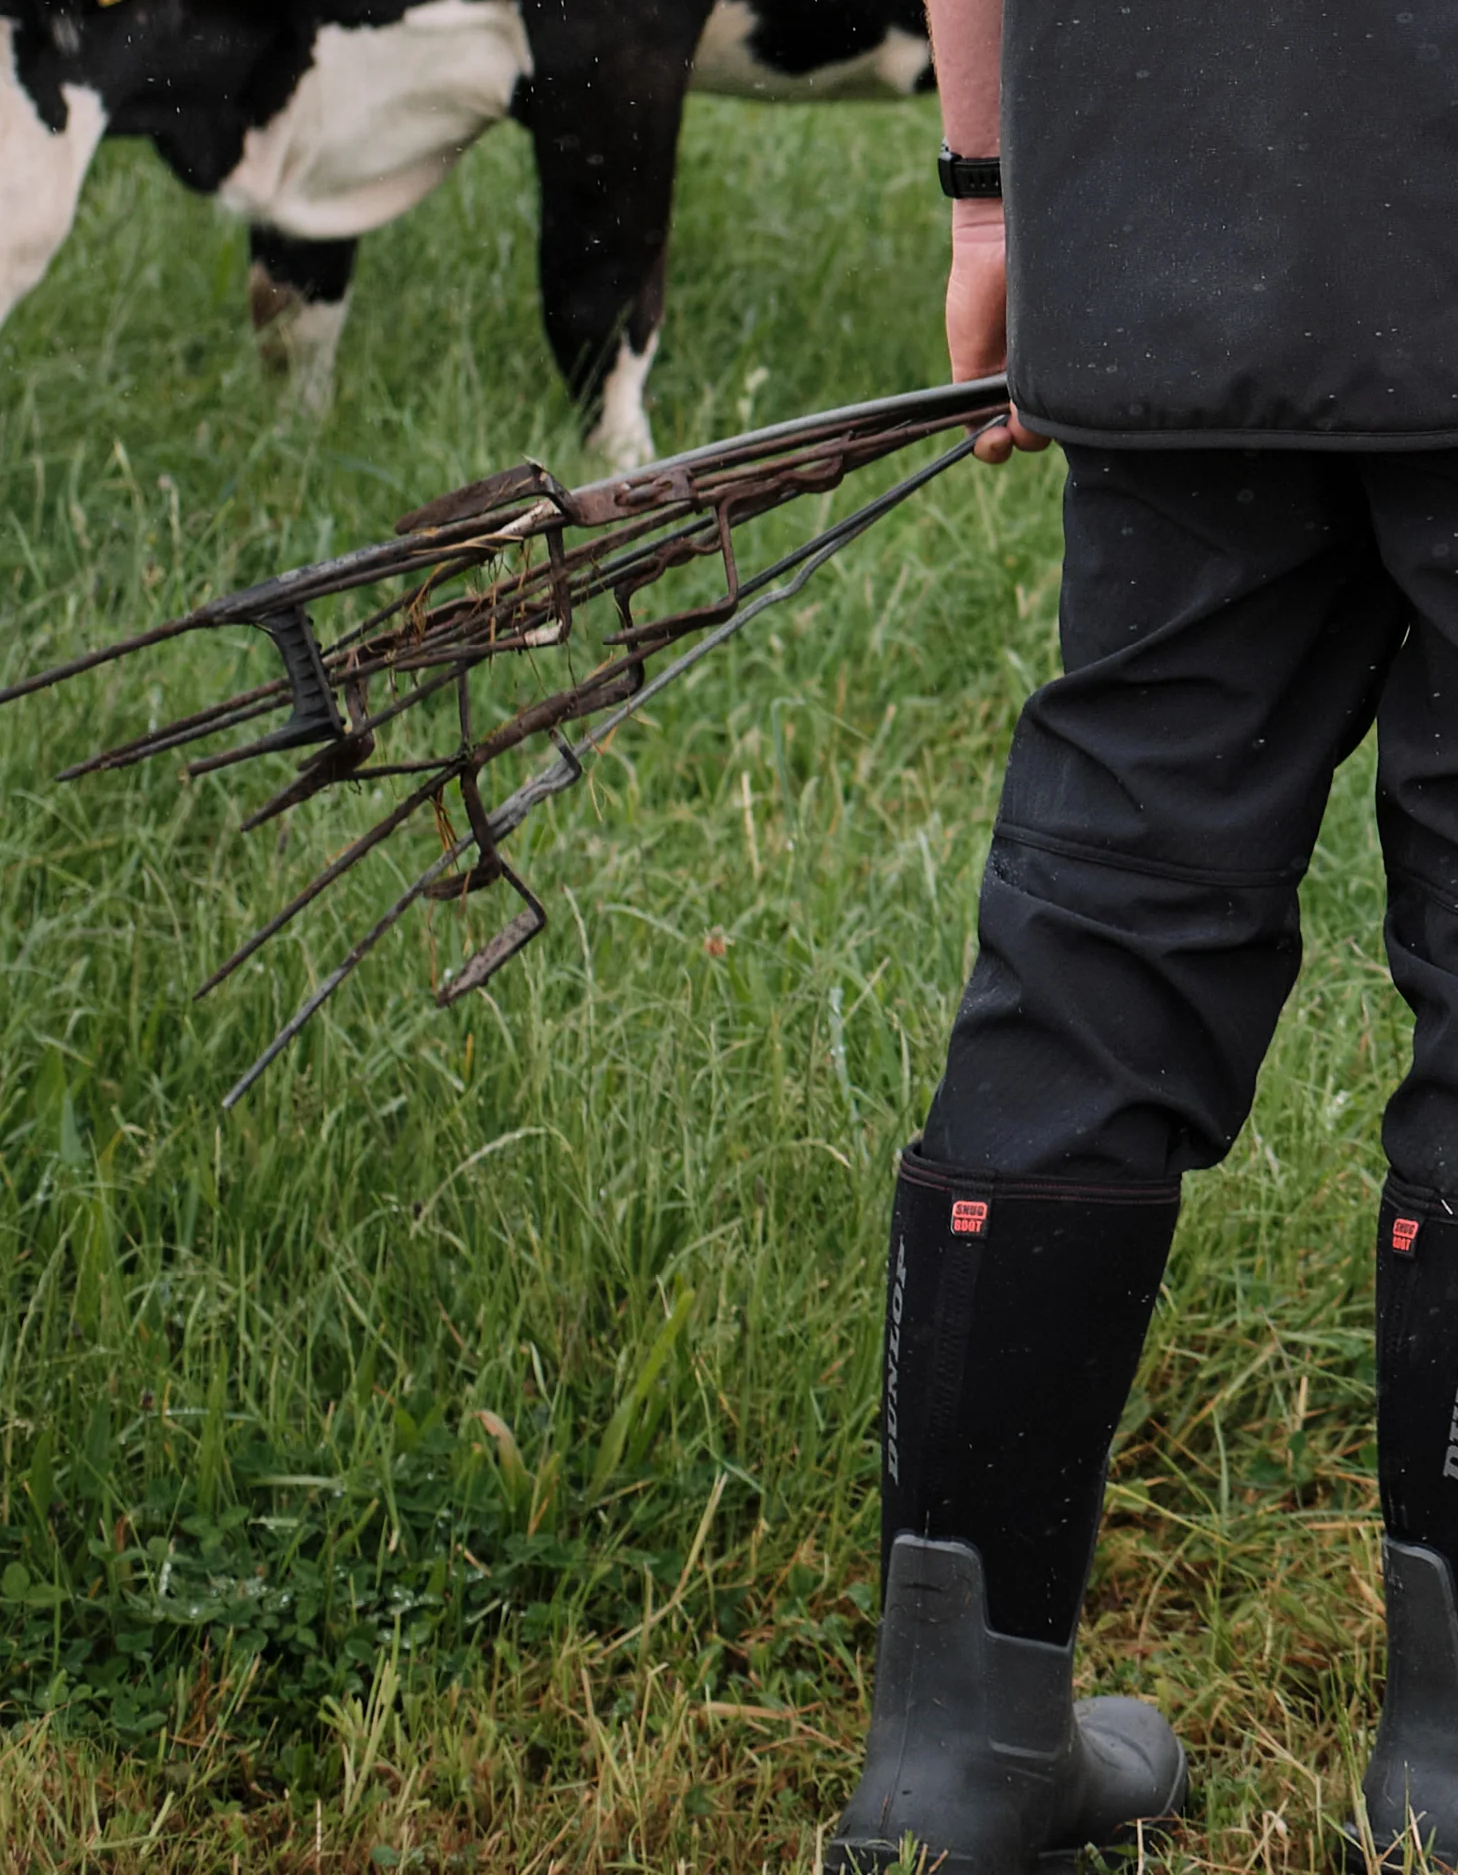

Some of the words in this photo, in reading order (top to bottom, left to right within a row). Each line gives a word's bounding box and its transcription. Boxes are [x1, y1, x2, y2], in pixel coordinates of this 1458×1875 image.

[955, 1203, 985, 1217] SNUG
[953, 1219, 982, 1232] BOOT
[888, 1235, 907, 1486] DUNLOP
